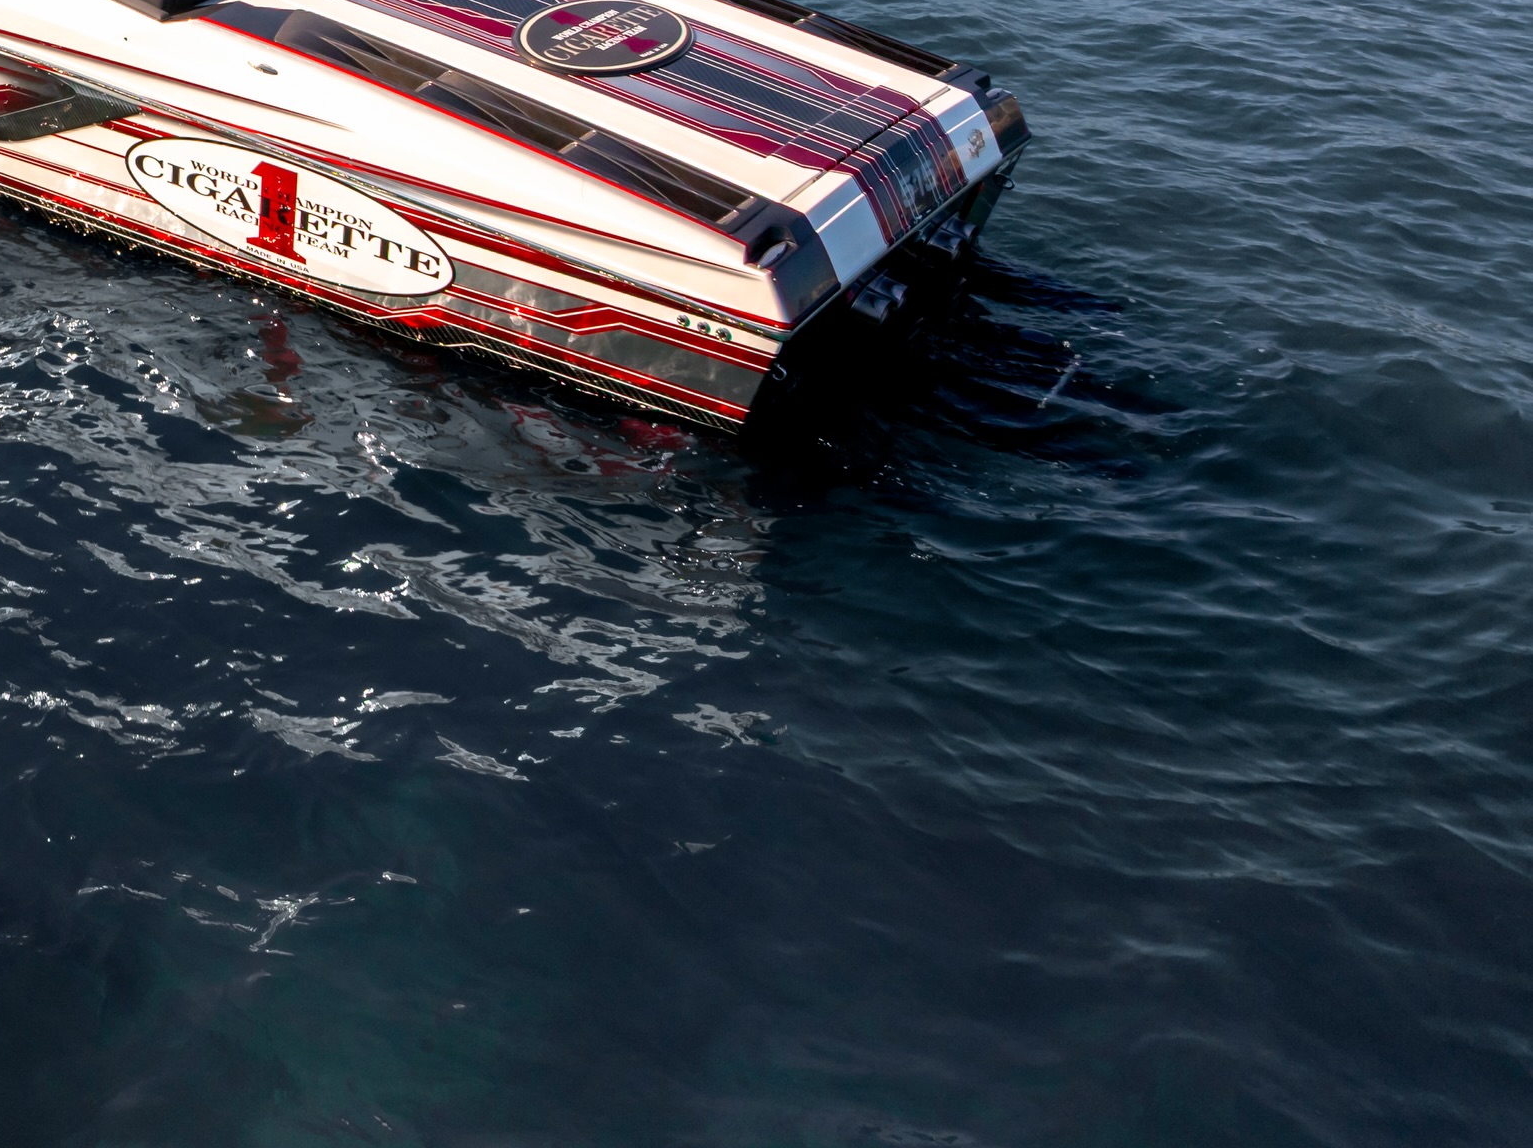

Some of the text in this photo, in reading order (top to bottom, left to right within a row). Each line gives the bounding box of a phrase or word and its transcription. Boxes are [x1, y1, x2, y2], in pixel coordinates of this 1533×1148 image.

[543, 5, 664, 62] CIGARETTE
[190, 159, 259, 191] WORLD
[135, 154, 441, 279] CIGARETTE
[246, 160, 307, 265] 1
[246, 245, 310, 273] MADE IN USA
[295, 231, 350, 259] TEAM
